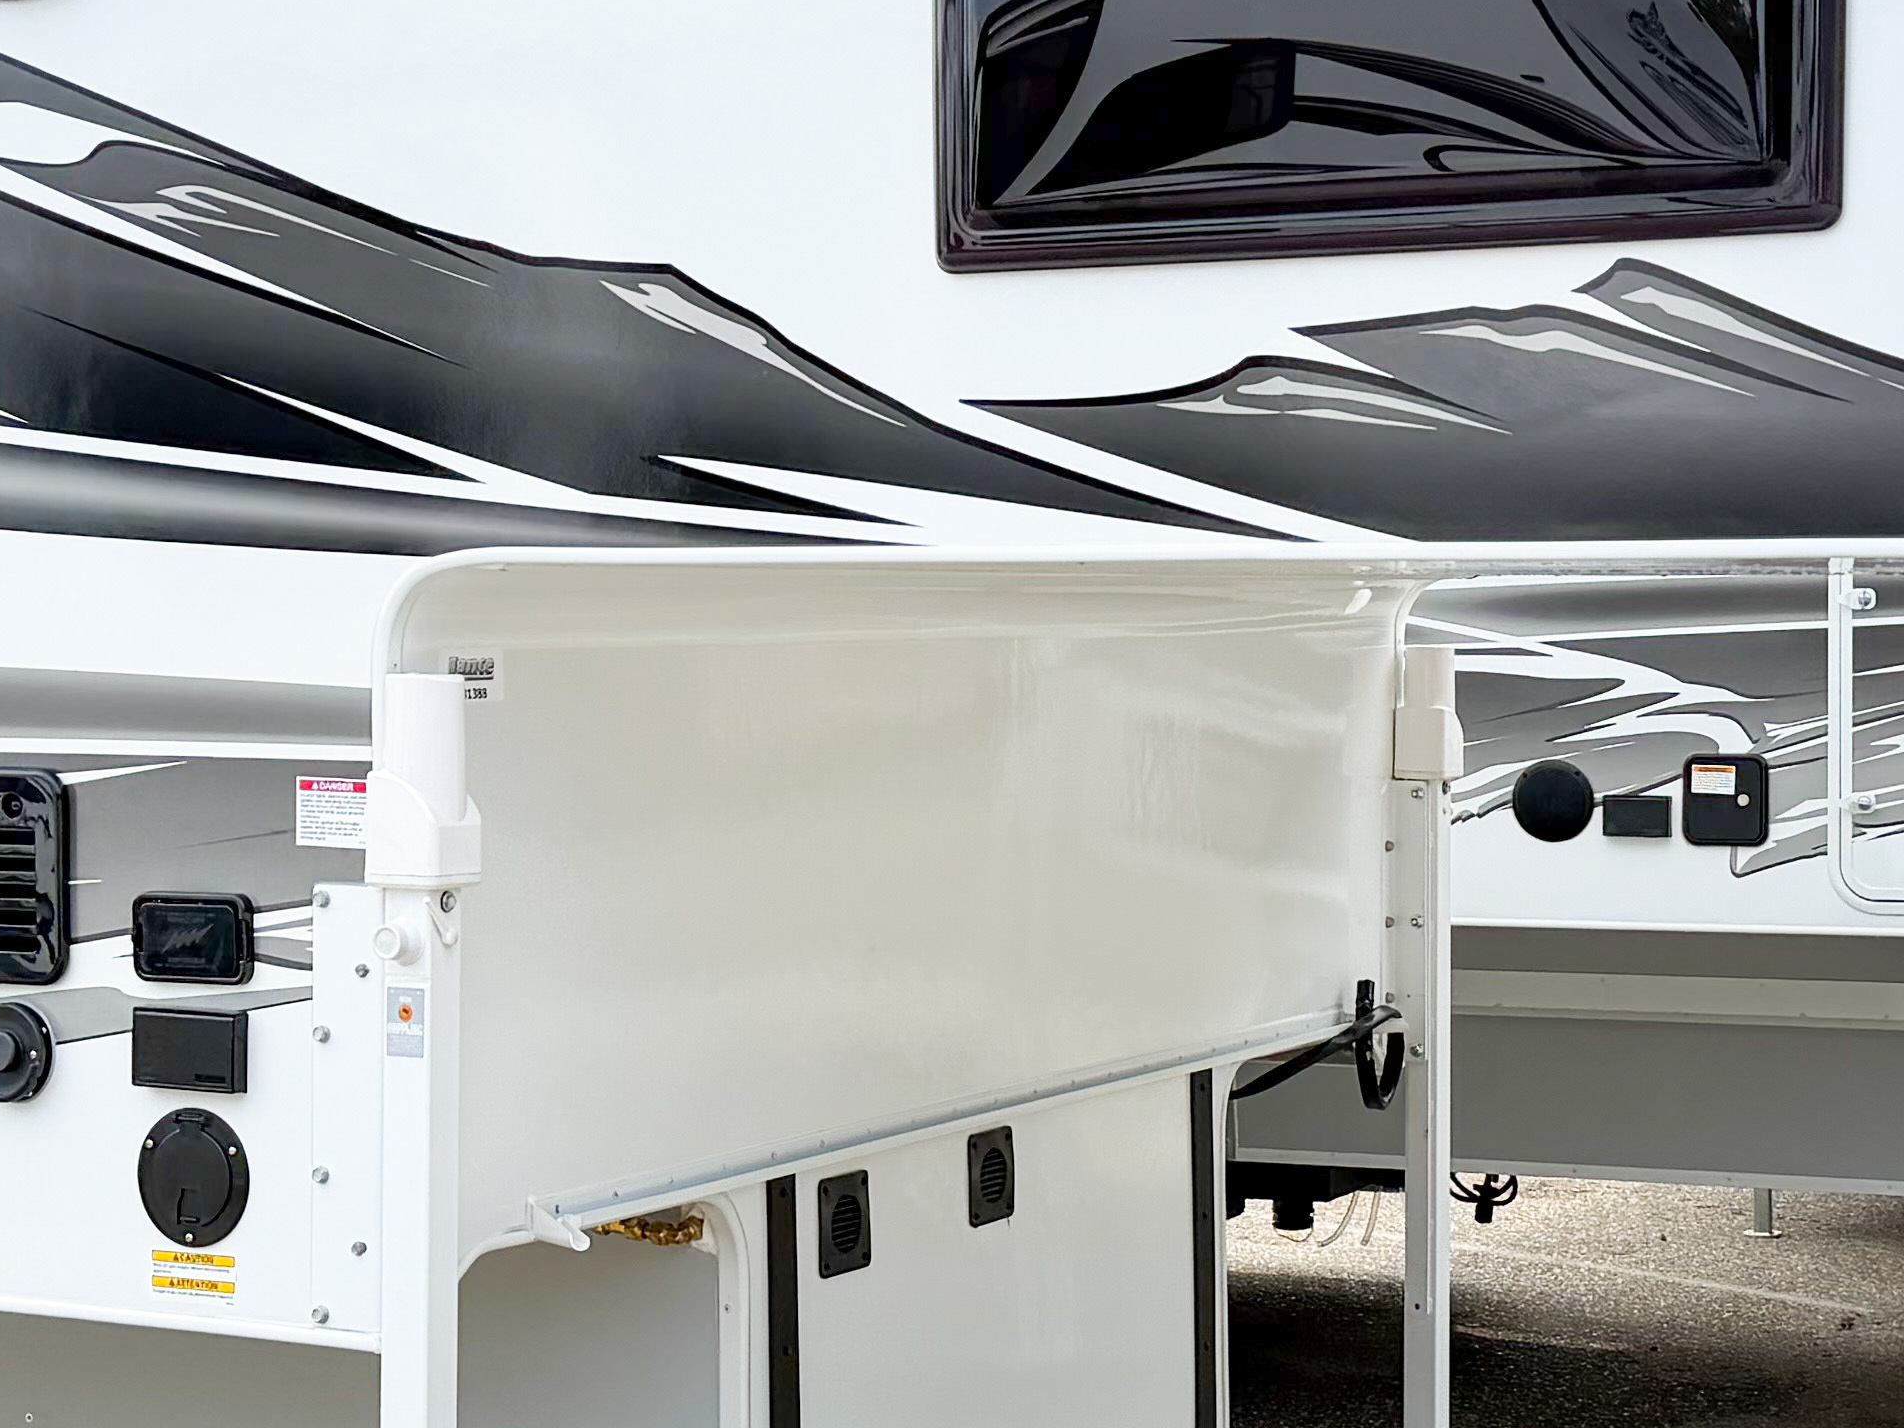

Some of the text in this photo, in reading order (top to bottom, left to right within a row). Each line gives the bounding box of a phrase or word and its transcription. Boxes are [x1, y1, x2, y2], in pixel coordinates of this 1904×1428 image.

[448, 656, 494, 681] Lance
[319, 781, 354, 792] DANGER
[179, 1253, 214, 1265] CAUTION
[177, 1278, 218, 1290] ATTENTION
